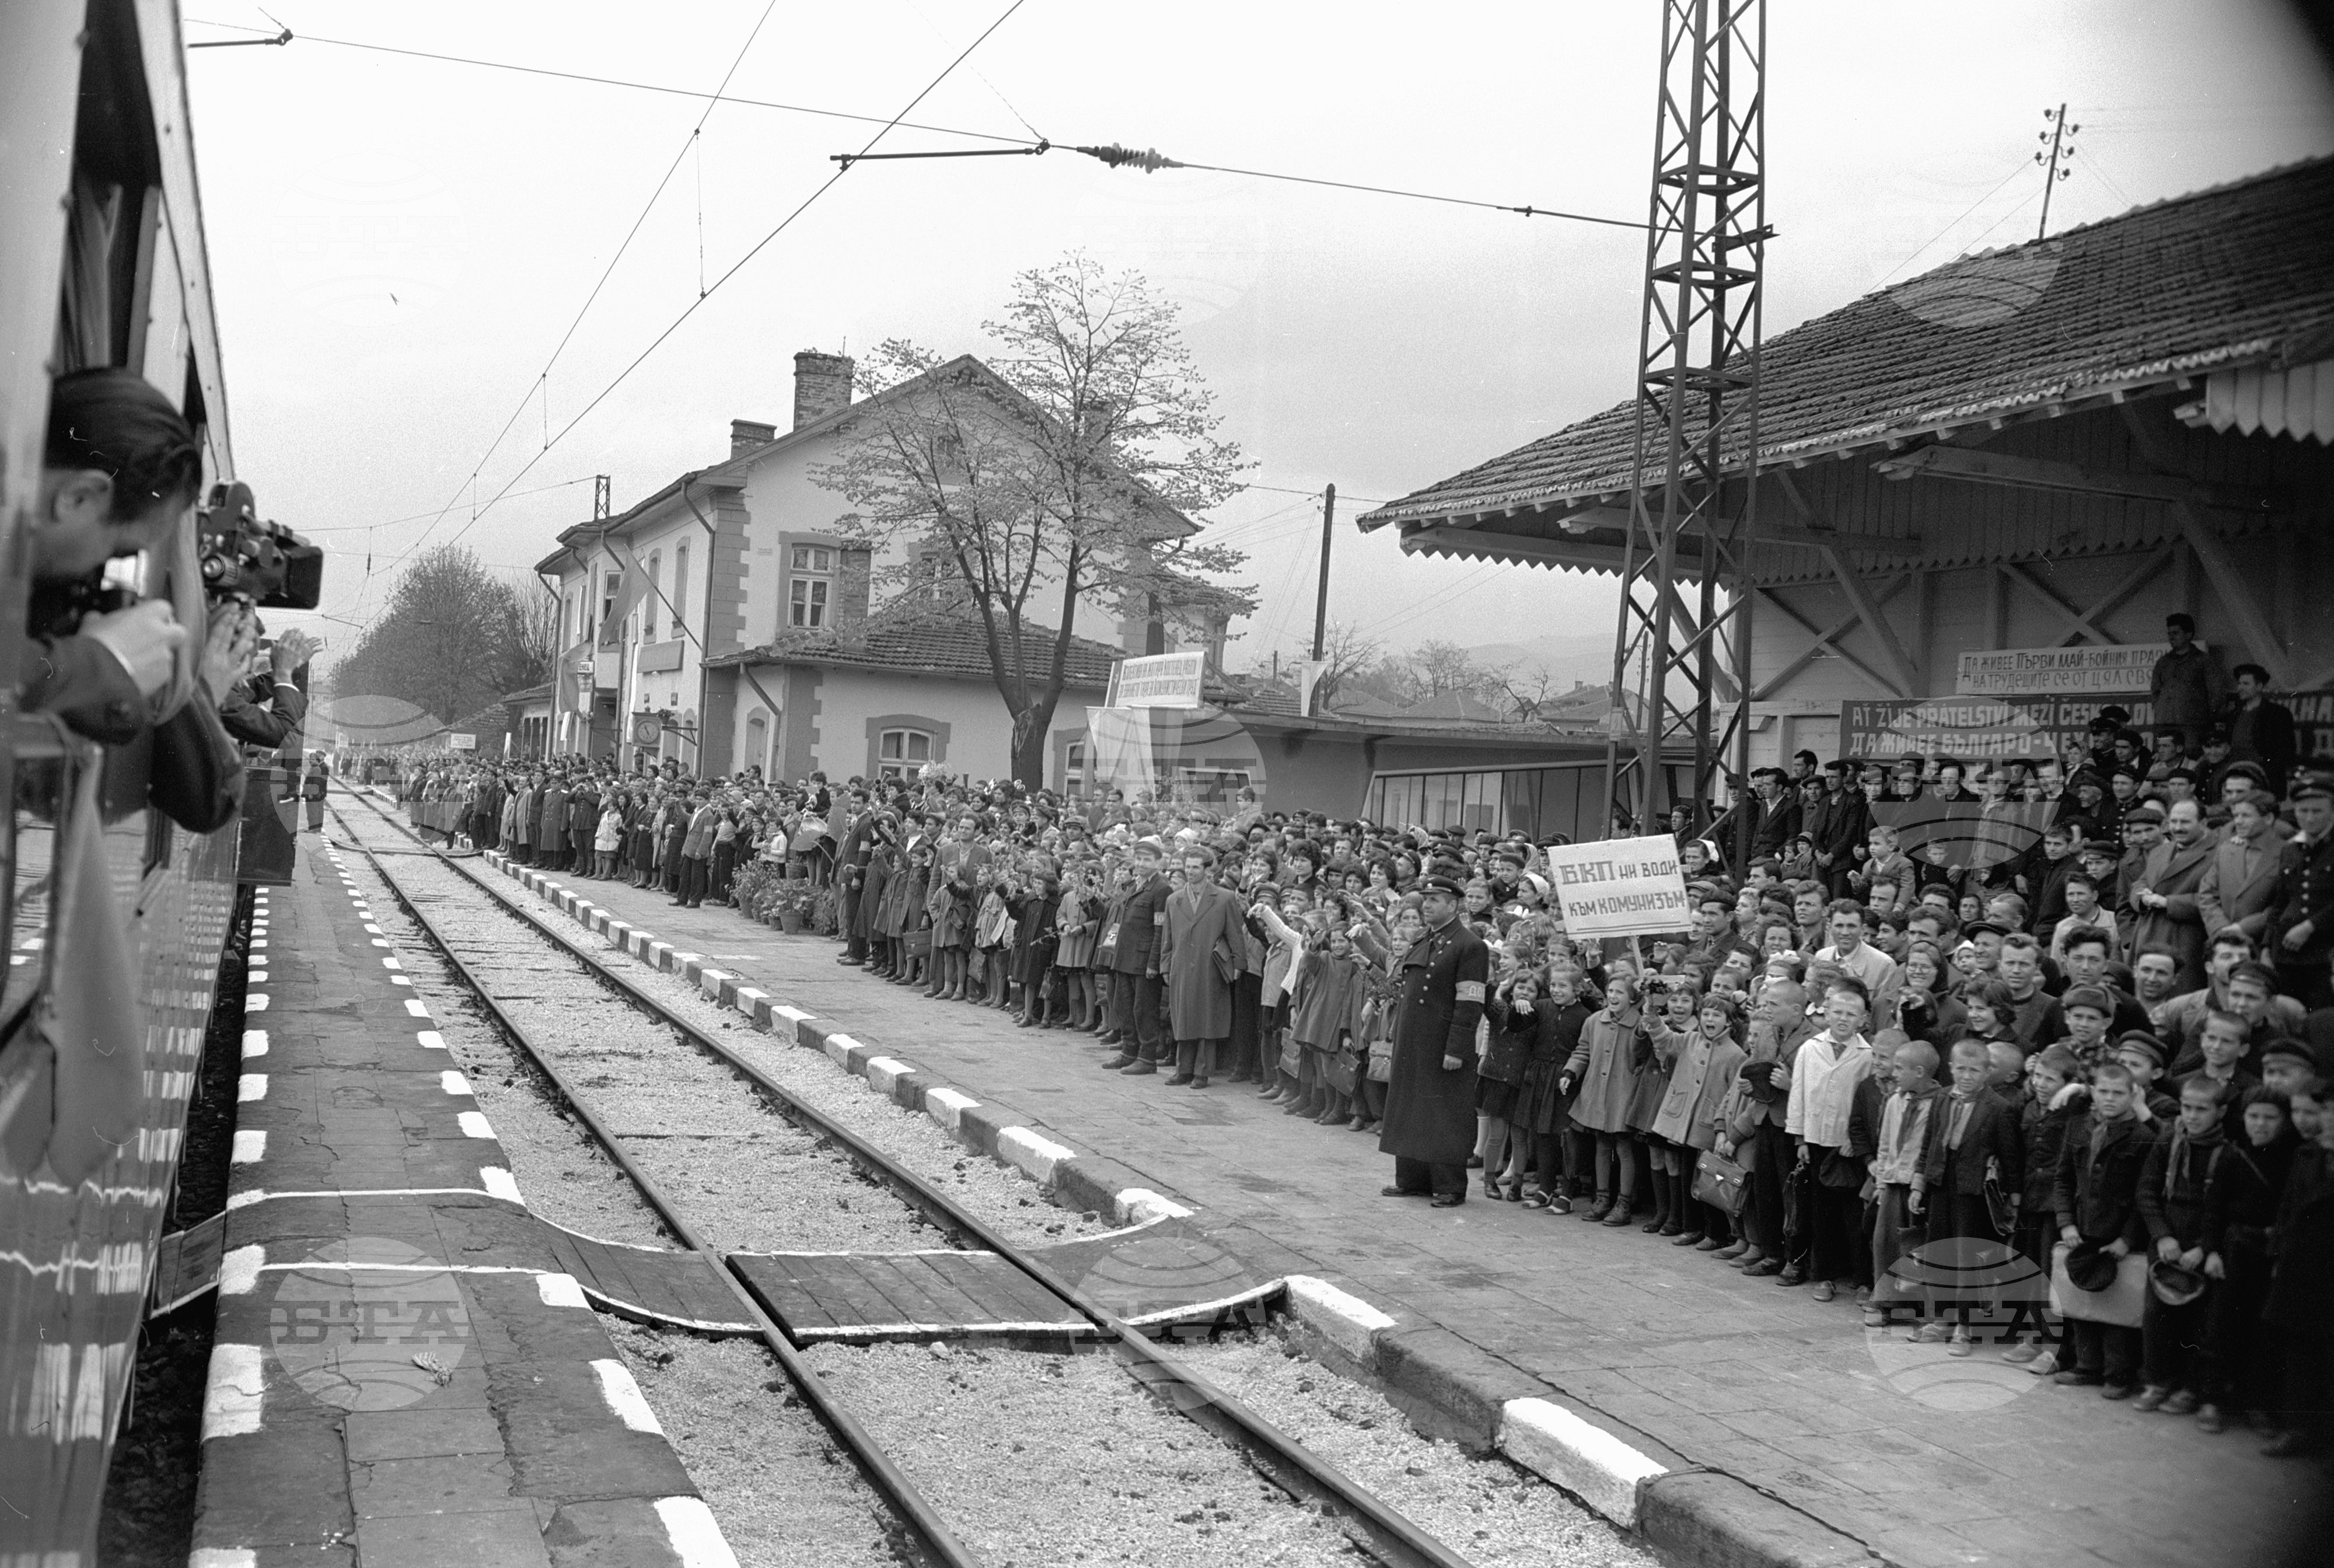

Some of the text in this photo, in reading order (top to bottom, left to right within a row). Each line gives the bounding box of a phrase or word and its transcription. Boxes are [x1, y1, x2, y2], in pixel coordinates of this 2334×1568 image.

[1963, 656, 1977, 682] ДА
[1982, 656, 2013, 670] ЖИВЕЕ
[2016, 652, 2055, 669] ПЪРВИ
[1973, 675, 1986, 688] НА
[2073, 671, 2087, 688] ОТ
[2126, 669, 2153, 685] СВЯ
[1853, 703, 1871, 727] AŤ
[1849, 732, 1876, 756] ДА
[1880, 734, 1937, 755] ЖИВЕЕ
[1559, 860, 1679, 885] БКП НИ ВОДИ
[1568, 890, 1686, 917] КЪМ КОМУНИЗЪМ
